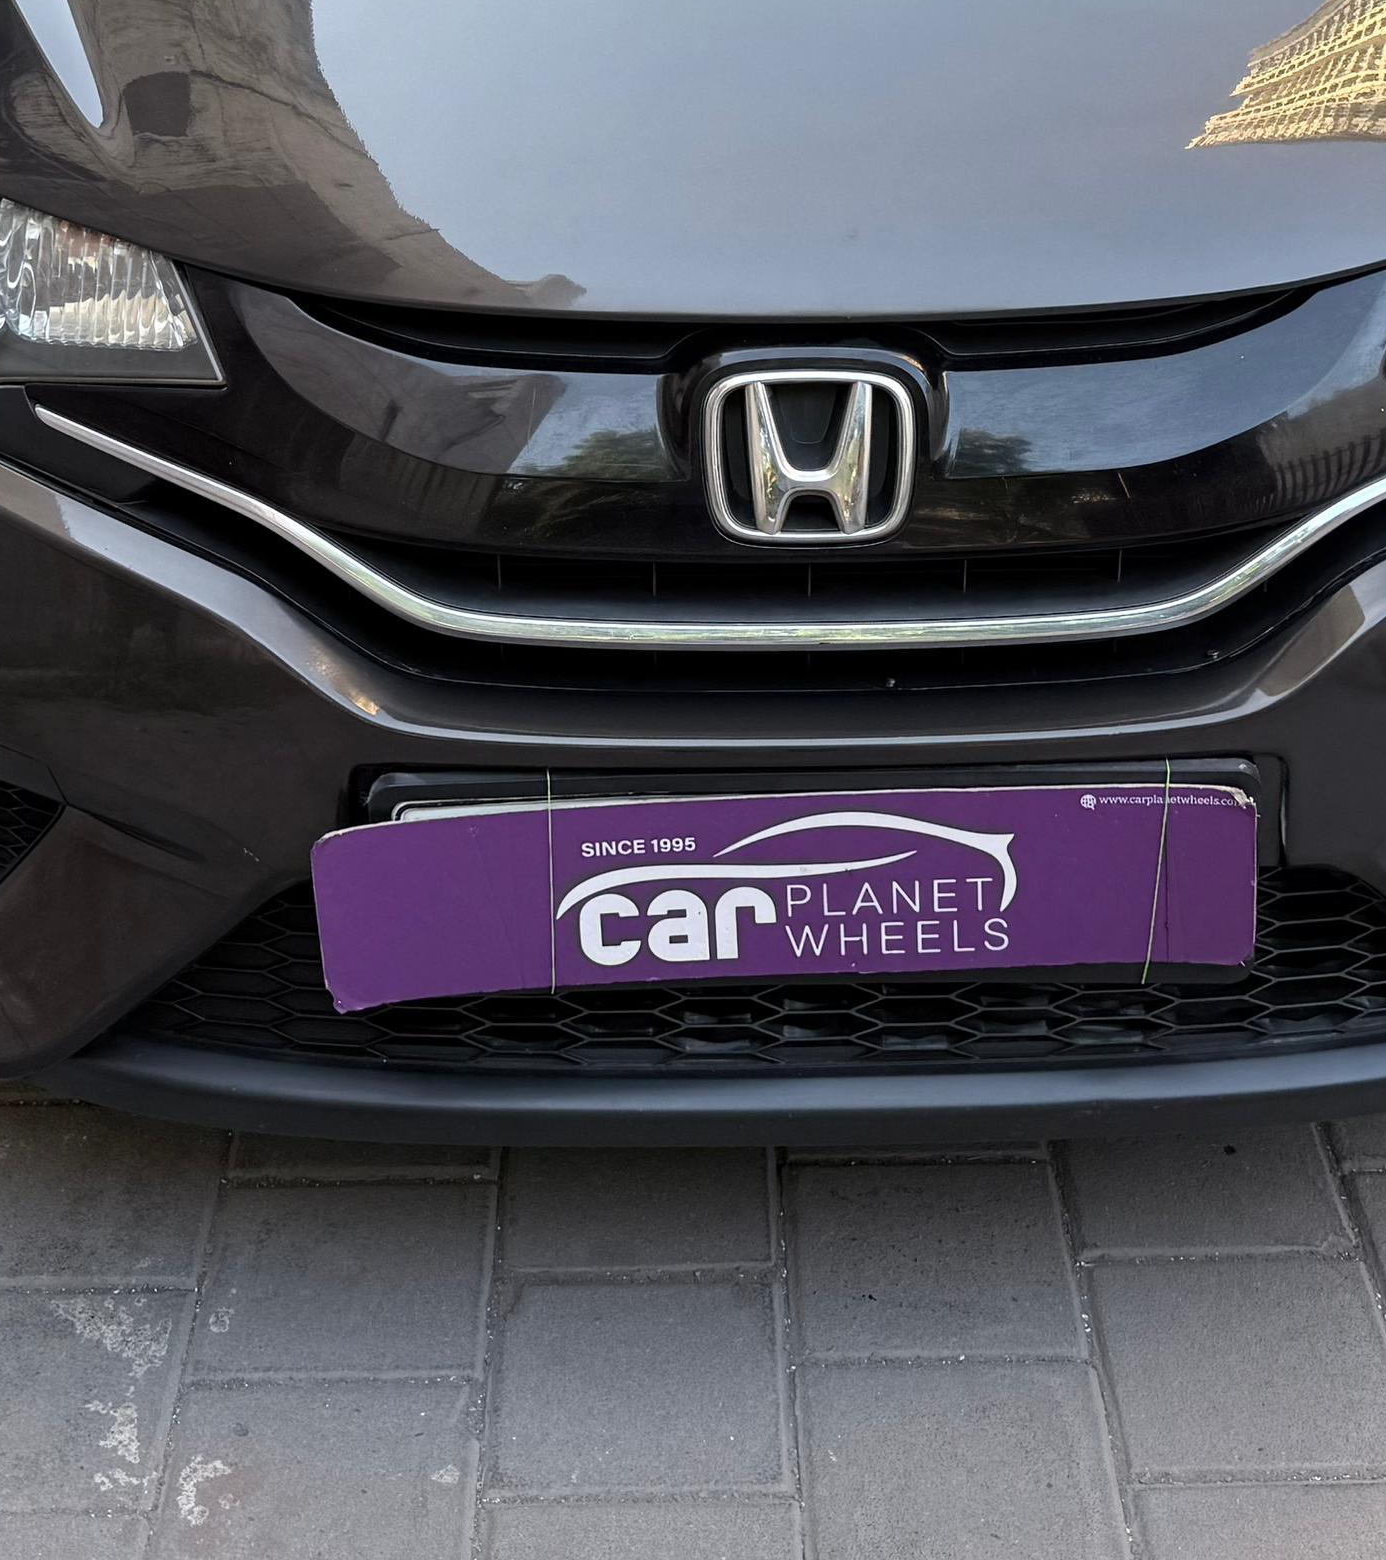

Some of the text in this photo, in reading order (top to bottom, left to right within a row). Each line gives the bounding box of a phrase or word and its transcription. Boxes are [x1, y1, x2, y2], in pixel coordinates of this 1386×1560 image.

[581, 837, 697, 858] SINCE 1995
[786, 877, 994, 918] PLANET
[579, 886, 778, 966] car
[785, 918, 1011, 958] WHEELS
